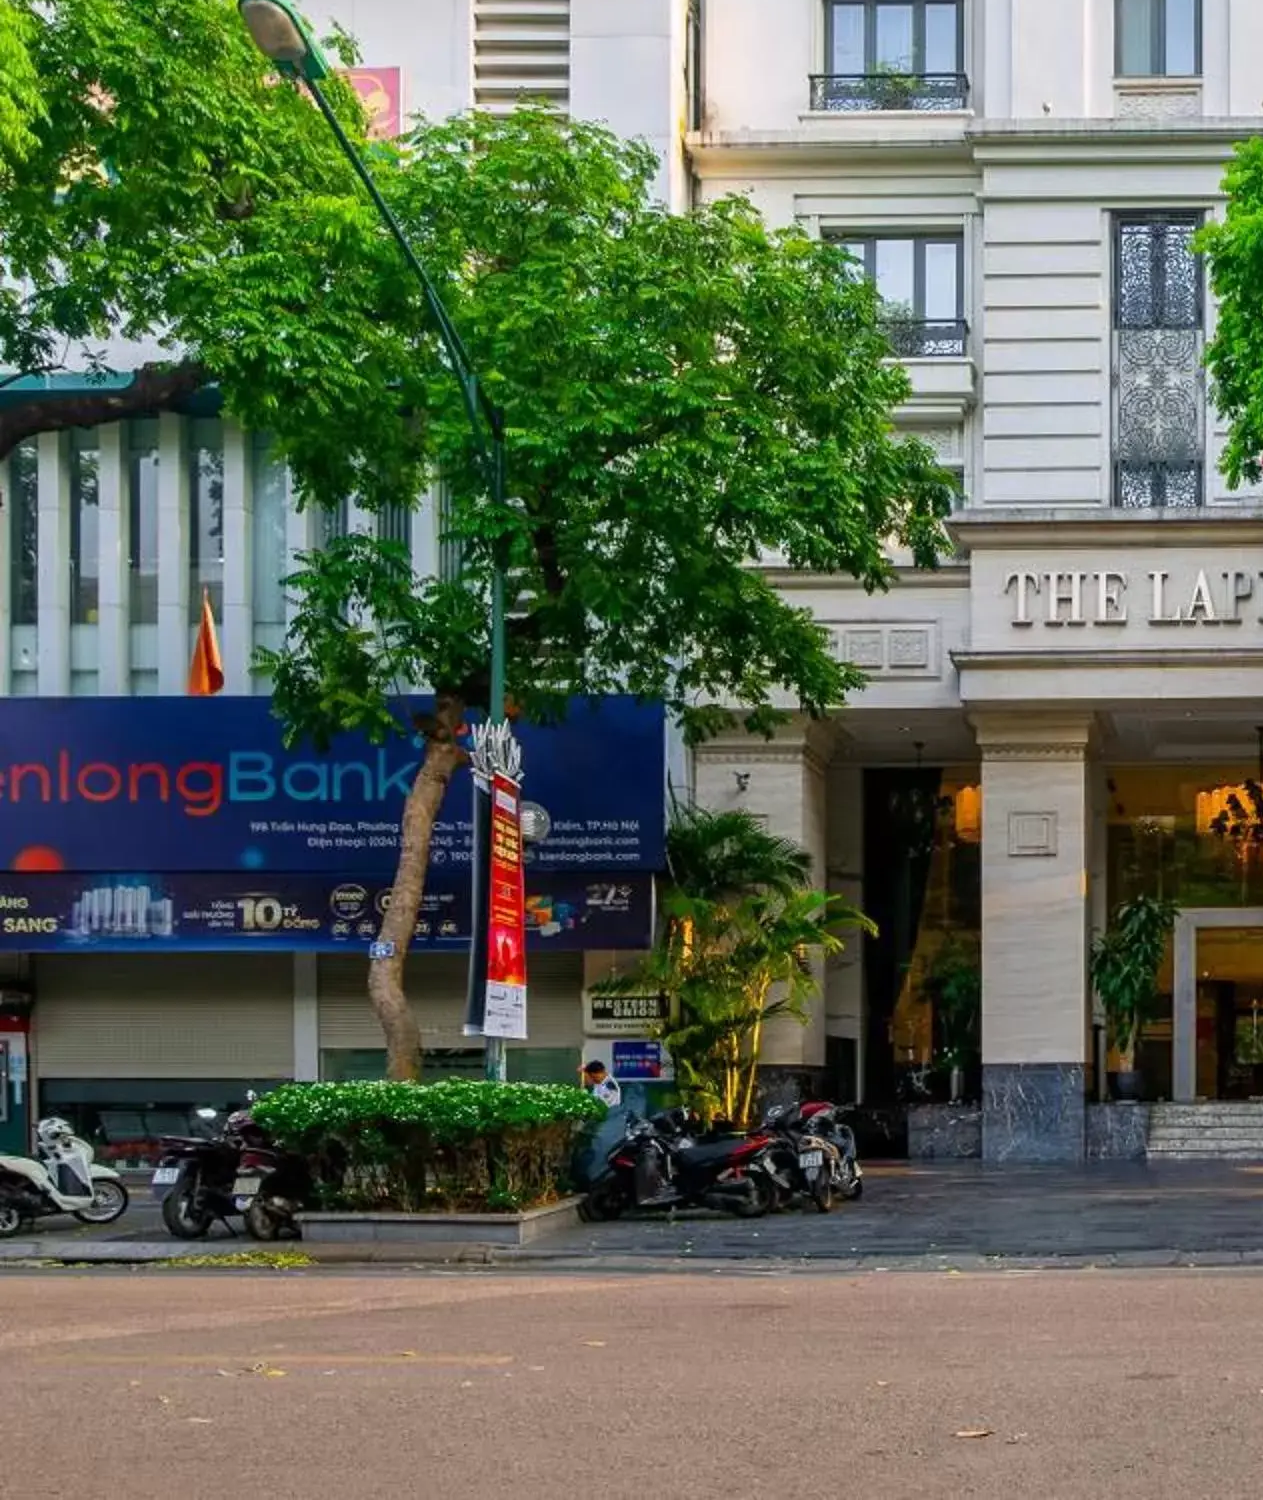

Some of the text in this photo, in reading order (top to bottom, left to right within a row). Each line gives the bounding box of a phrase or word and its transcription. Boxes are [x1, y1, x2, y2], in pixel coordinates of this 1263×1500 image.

[1004, 571, 1127, 627] THE
[0, 747, 419, 816] nlongBank
[238, 898, 282, 928] 10
